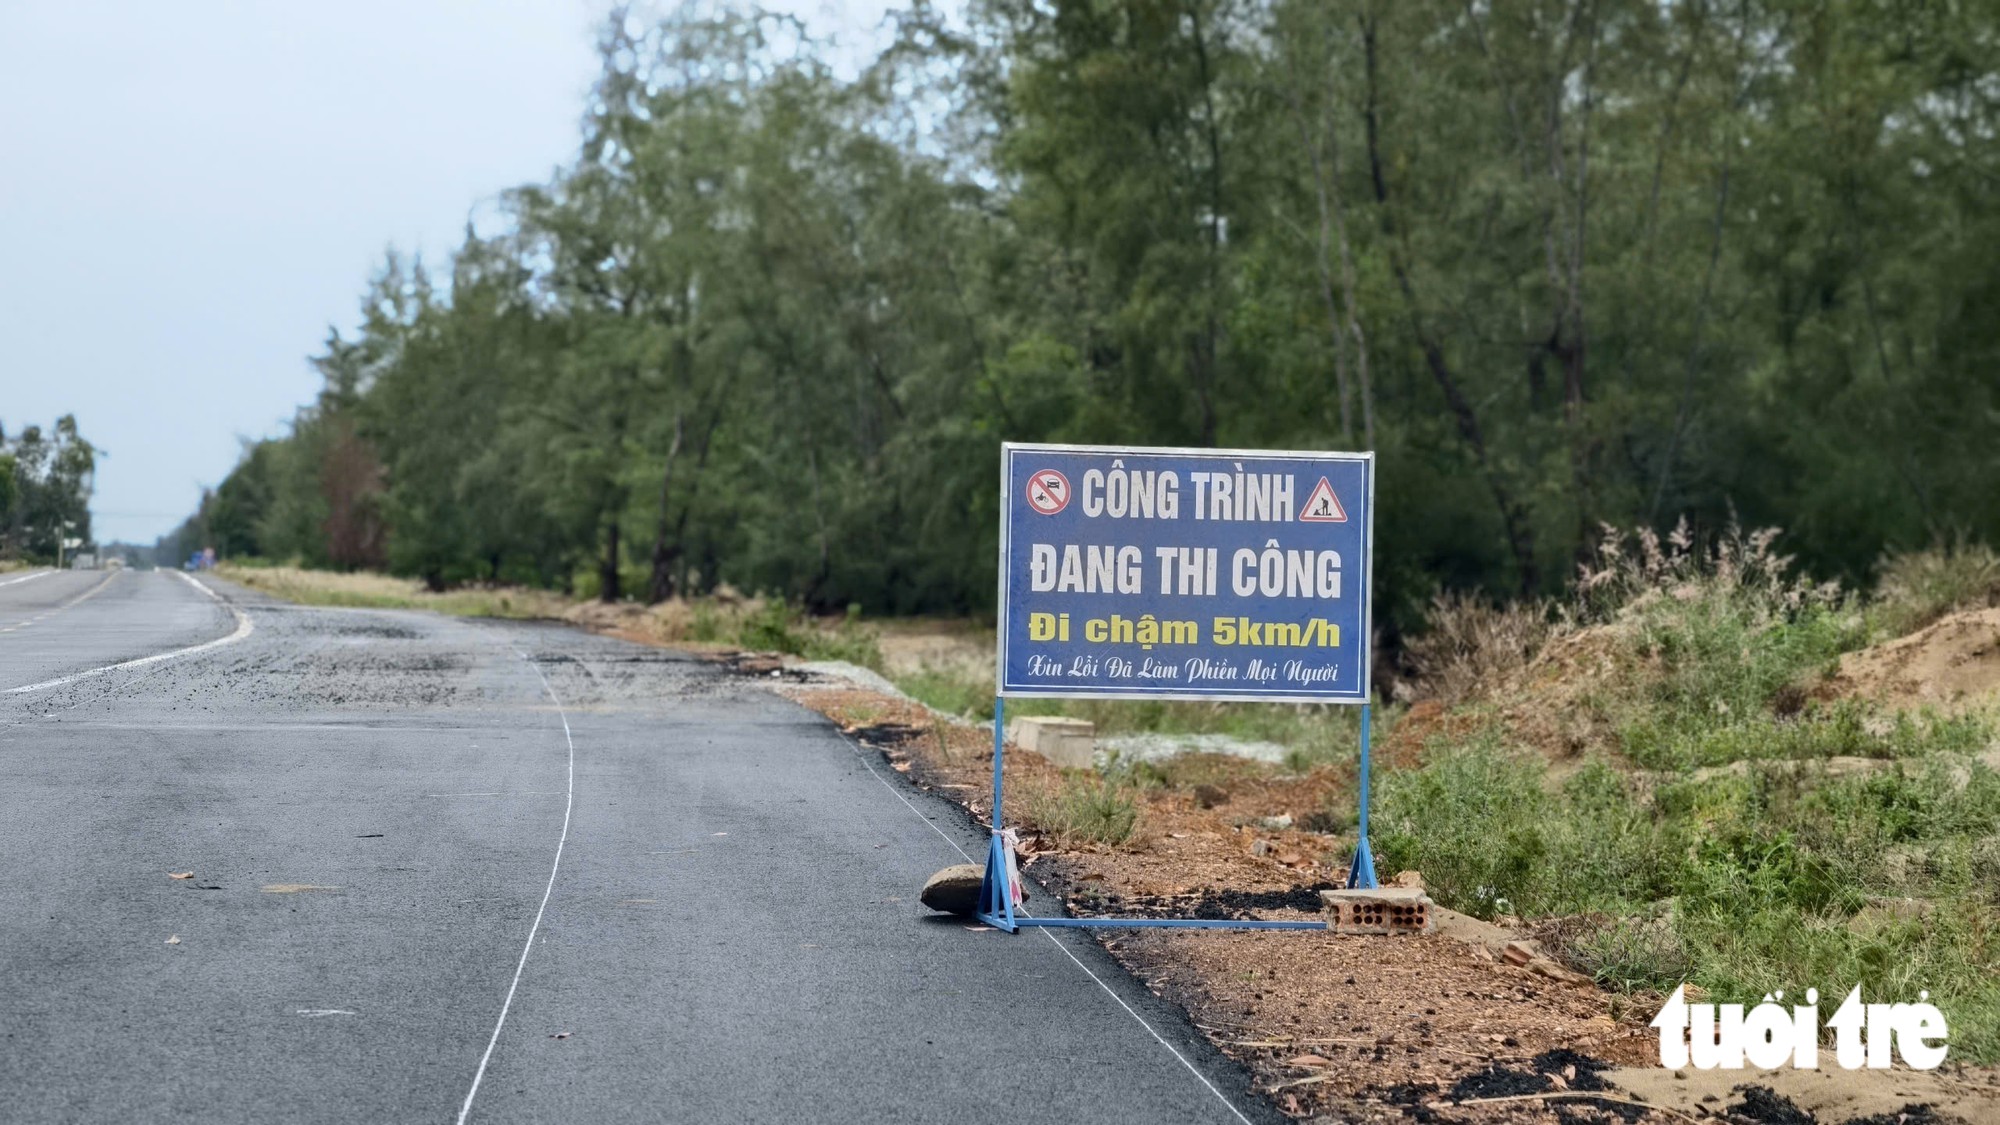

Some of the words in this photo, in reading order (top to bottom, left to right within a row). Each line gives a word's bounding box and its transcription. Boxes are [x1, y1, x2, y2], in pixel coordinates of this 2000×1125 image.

[1082, 459, 1179, 519] CÔNG
[1191, 462, 1294, 522] TRÌNH
[1030, 543, 1142, 594] ĐANG
[1156, 547, 1217, 596] THI
[1232, 539, 1342, 598] CÔNG
[1028, 613, 1069, 641] Đi
[1085, 614, 1198, 650] chậm
[1213, 617, 1340, 647] 5km/h
[1027, 654, 1062, 677] Xin
[1068, 655, 1099, 677] Lỗi
[1104, 656, 1132, 678] Đã
[1138, 658, 1178, 679] Làm
[1184, 657, 1238, 682] Phiền
[1242, 659, 1278, 685] Mọi
[1283, 661, 1338, 686] Người
